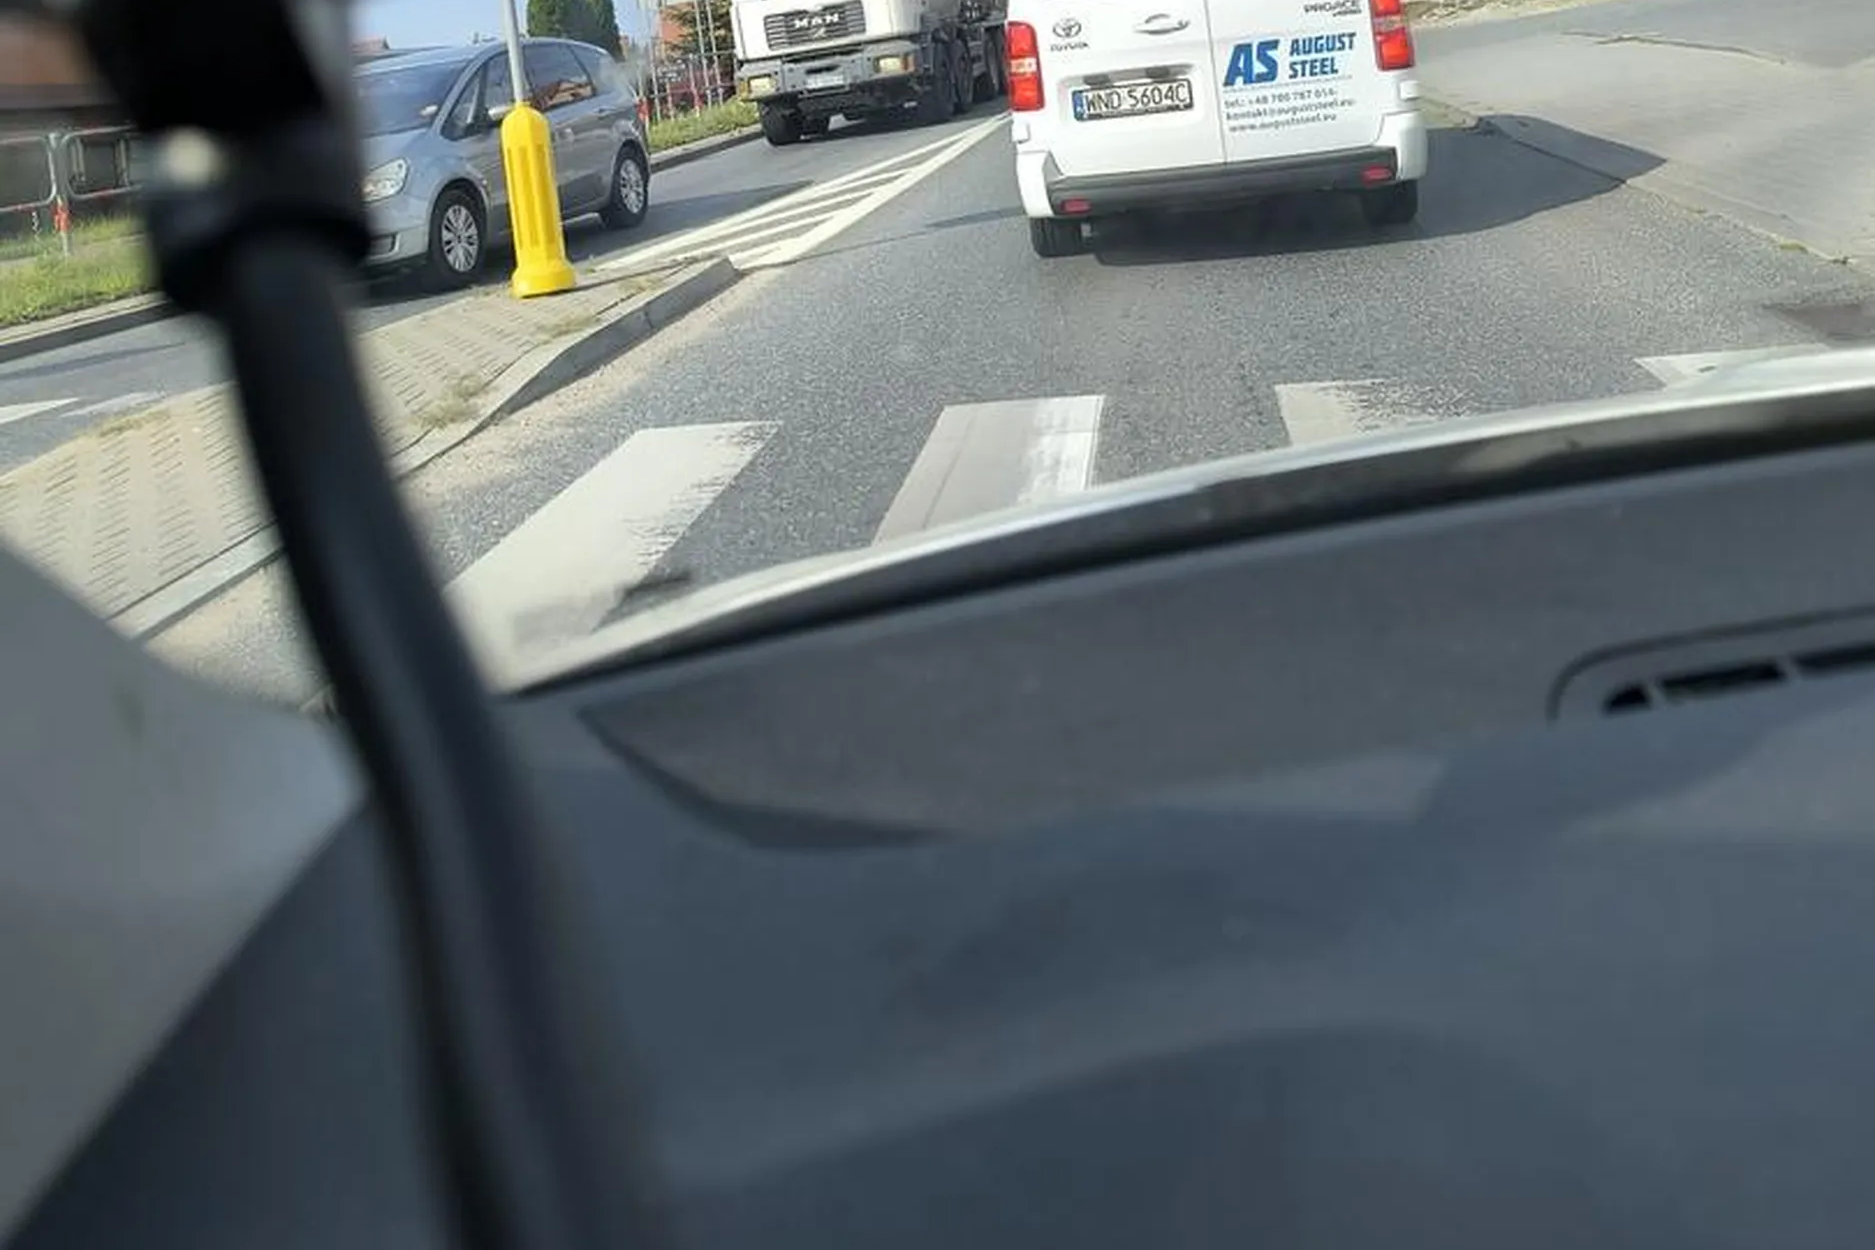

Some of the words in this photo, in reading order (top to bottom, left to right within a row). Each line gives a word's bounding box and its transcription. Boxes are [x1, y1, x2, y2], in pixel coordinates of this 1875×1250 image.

[794, 12, 839, 29] MAN
[1288, 31, 1357, 57] AUGUST
[1222, 38, 1281, 88] AS
[1288, 56, 1339, 80] STEEL
[1083, 90, 1122, 113] WND
[1127, 82, 1188, 108] 5604C
